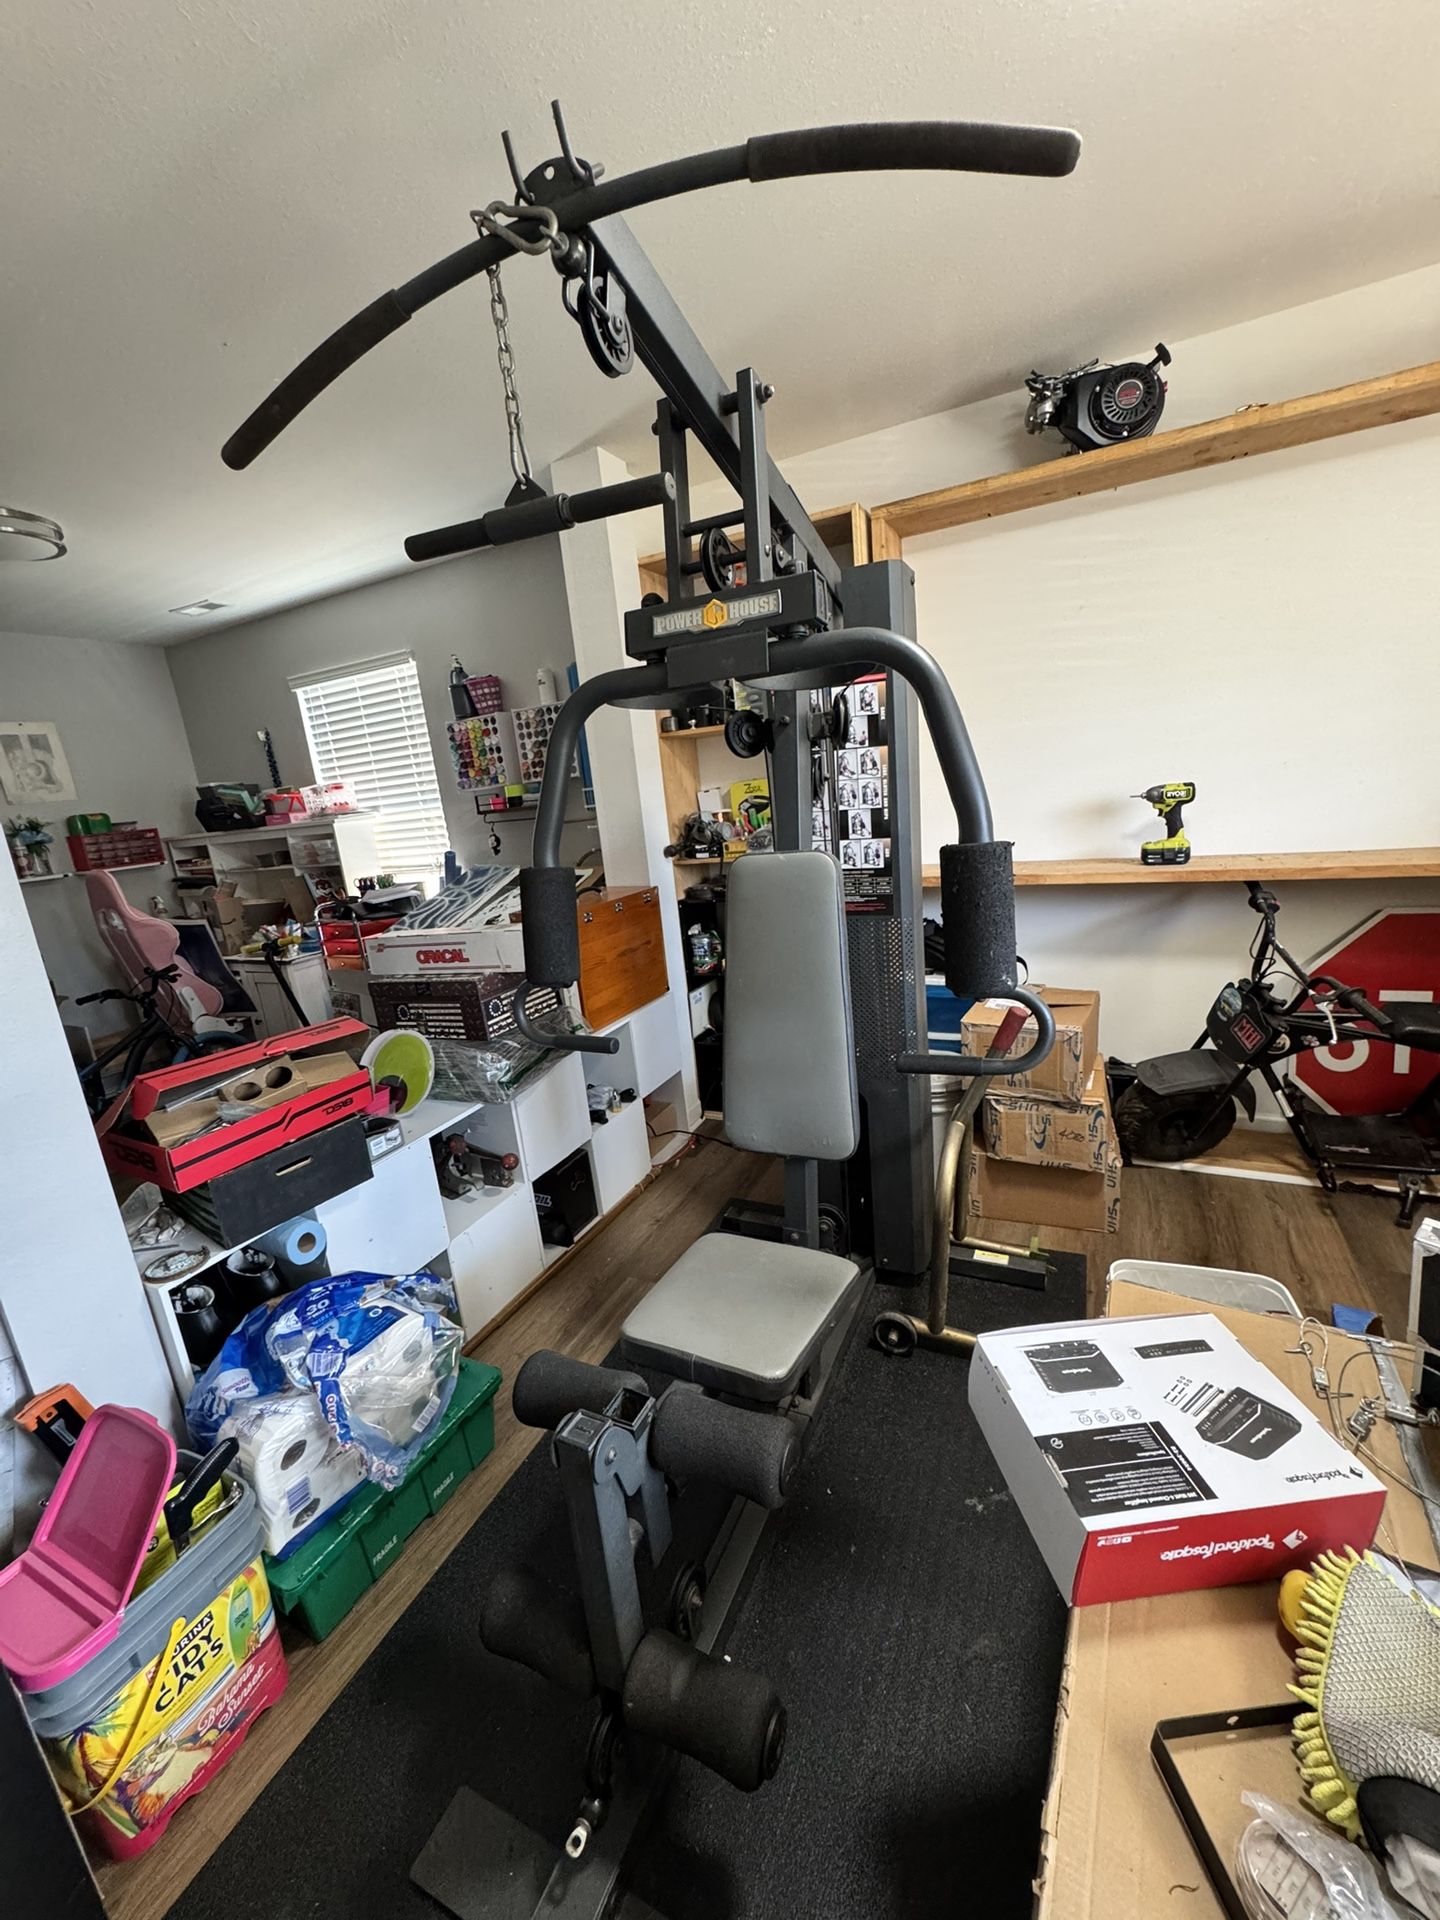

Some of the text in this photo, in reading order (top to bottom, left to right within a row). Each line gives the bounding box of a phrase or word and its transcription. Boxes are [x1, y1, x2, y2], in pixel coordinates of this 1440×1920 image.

[654, 594, 778, 633] POWER HOUSE
[416, 949, 470, 964] ORACAL
[1088, 1124, 1099, 1143] HS
[1093, 1151, 1104, 1171] HS
[306, 1299, 330, 1316] 30
[172, 1616, 213, 1656] URINA
[155, 1637, 224, 1713] CATS
[160, 1624, 215, 1692] IDY
[197, 1662, 256, 1738] Bahama
[217, 1661, 268, 1730] Sunset
